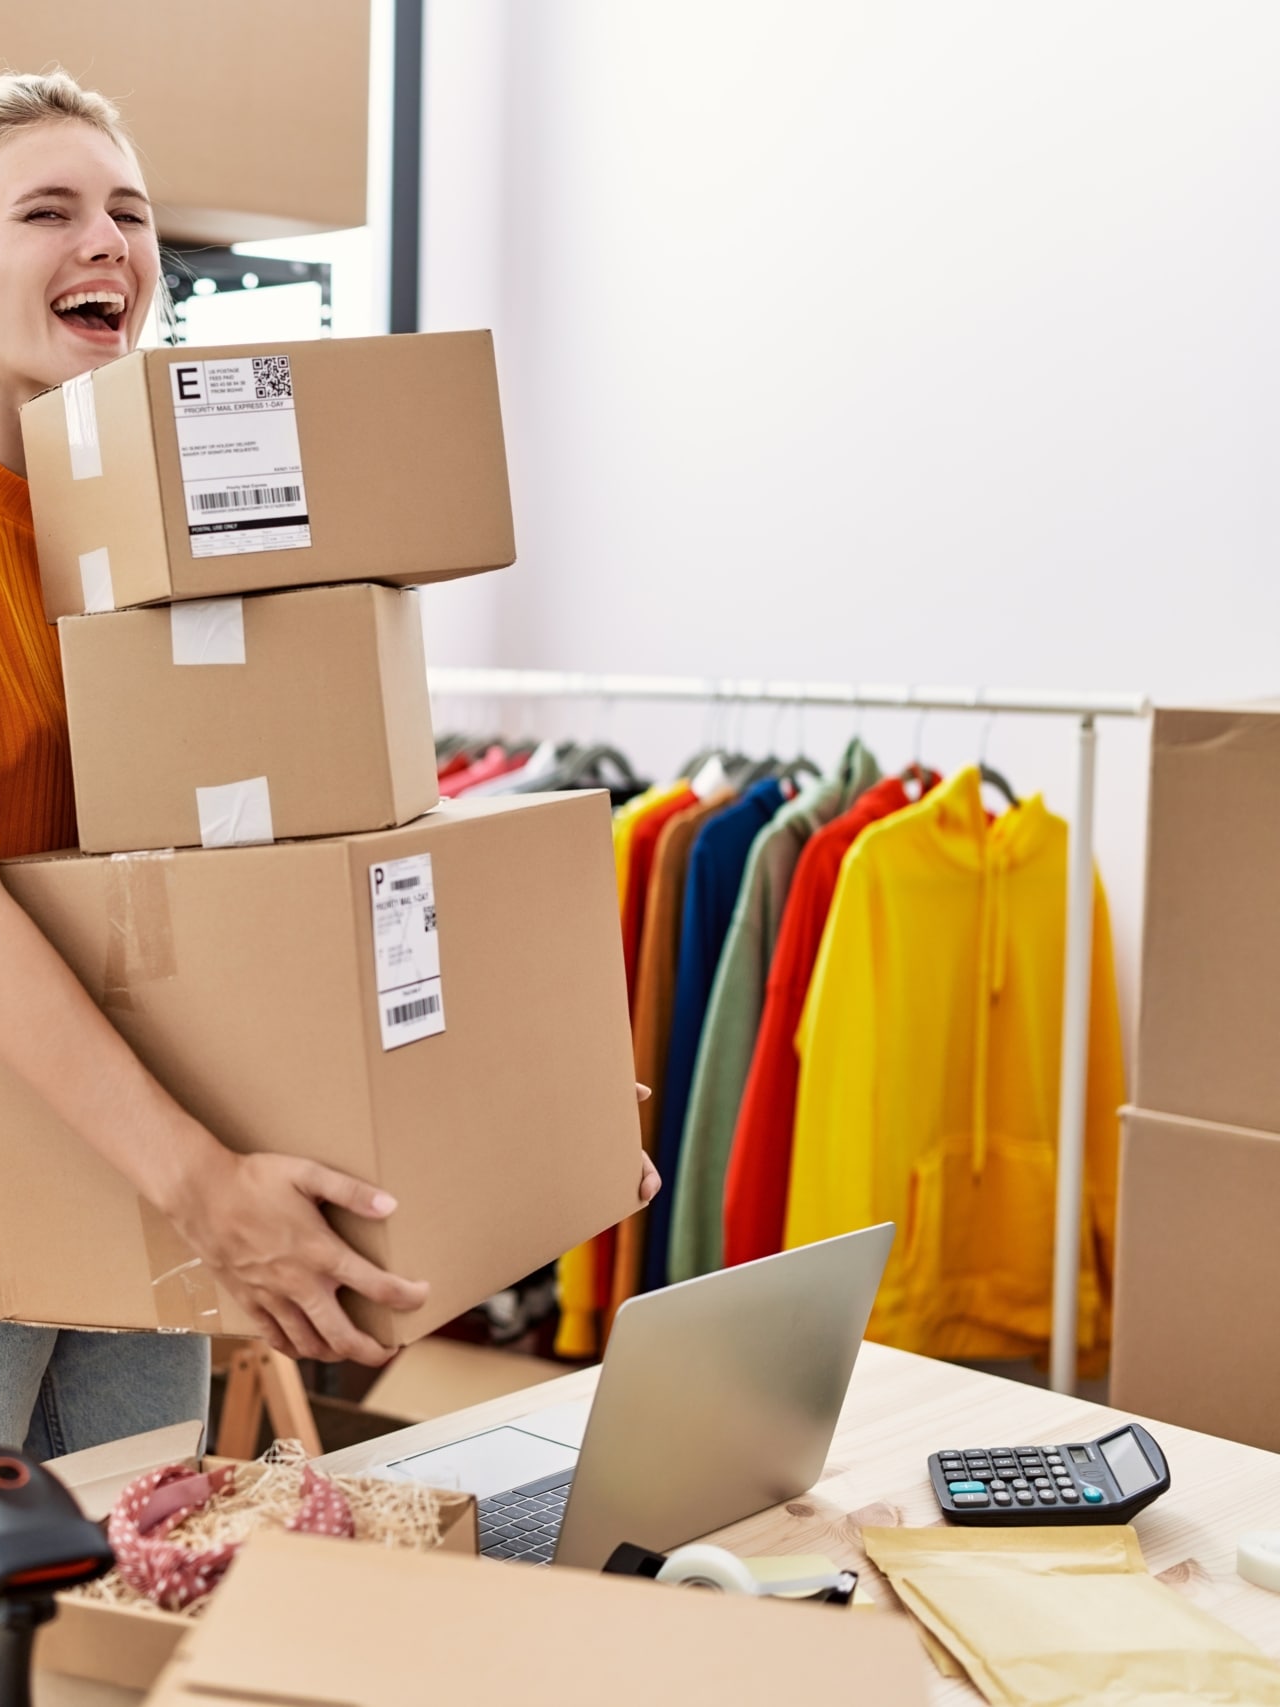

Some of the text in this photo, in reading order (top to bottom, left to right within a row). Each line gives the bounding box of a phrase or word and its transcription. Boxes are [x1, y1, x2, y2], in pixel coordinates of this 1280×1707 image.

[176, 367, 201, 400] E
[184, 405, 215, 414] PRIORITY
[216, 404, 232, 412] MAIL
[233, 402, 264, 411] EXPRESS
[374, 867, 384, 896] P
[400, 894, 413, 906] MAIL
